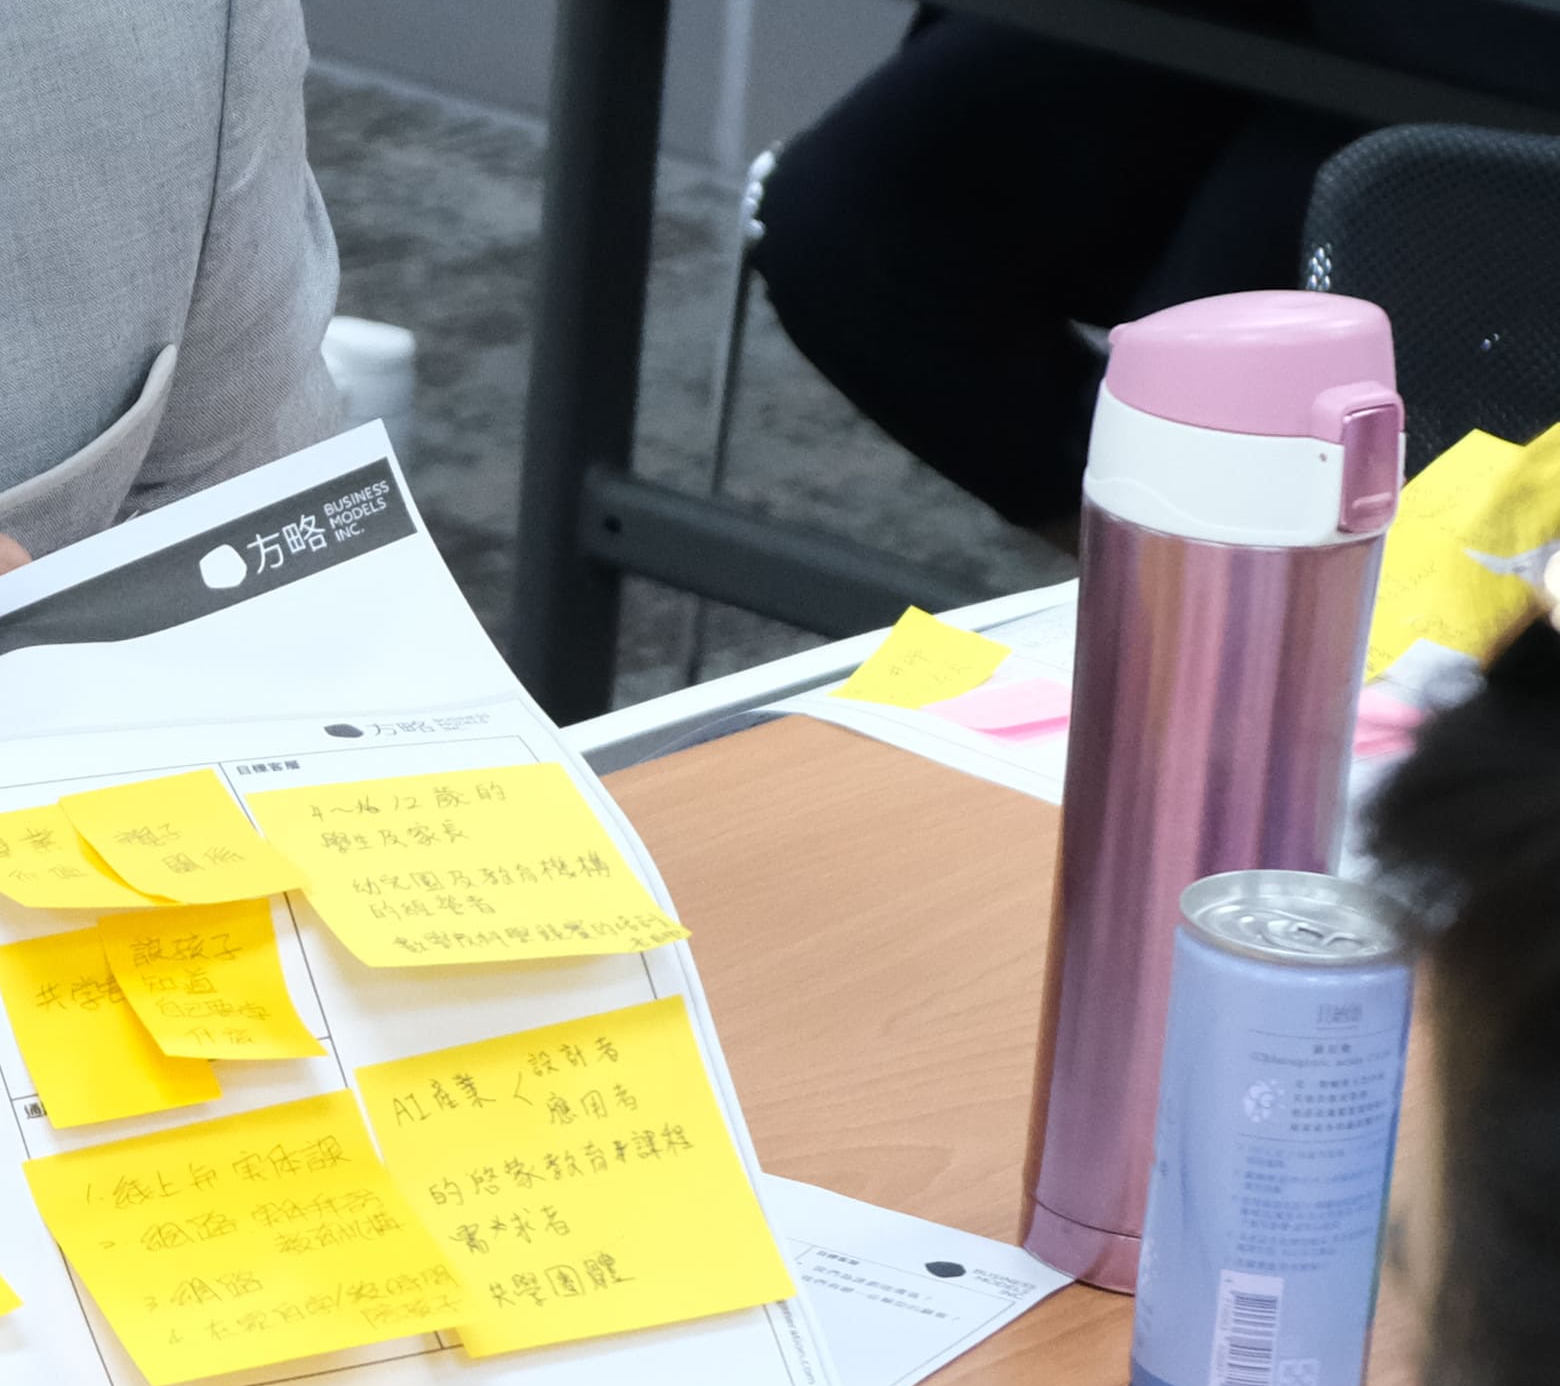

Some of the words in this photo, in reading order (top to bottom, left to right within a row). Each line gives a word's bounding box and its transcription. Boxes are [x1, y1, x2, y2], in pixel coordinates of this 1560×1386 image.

[323, 480, 390, 517] BUSINESS
[328, 497, 387, 529] MODELS
[247, 512, 327, 575] 方略
[334, 523, 365, 542] INC.
[236, 760, 301, 776] 目標客層
[527, 1036, 622, 1078] 設計者
[548, 1083, 639, 1126] 應用者
